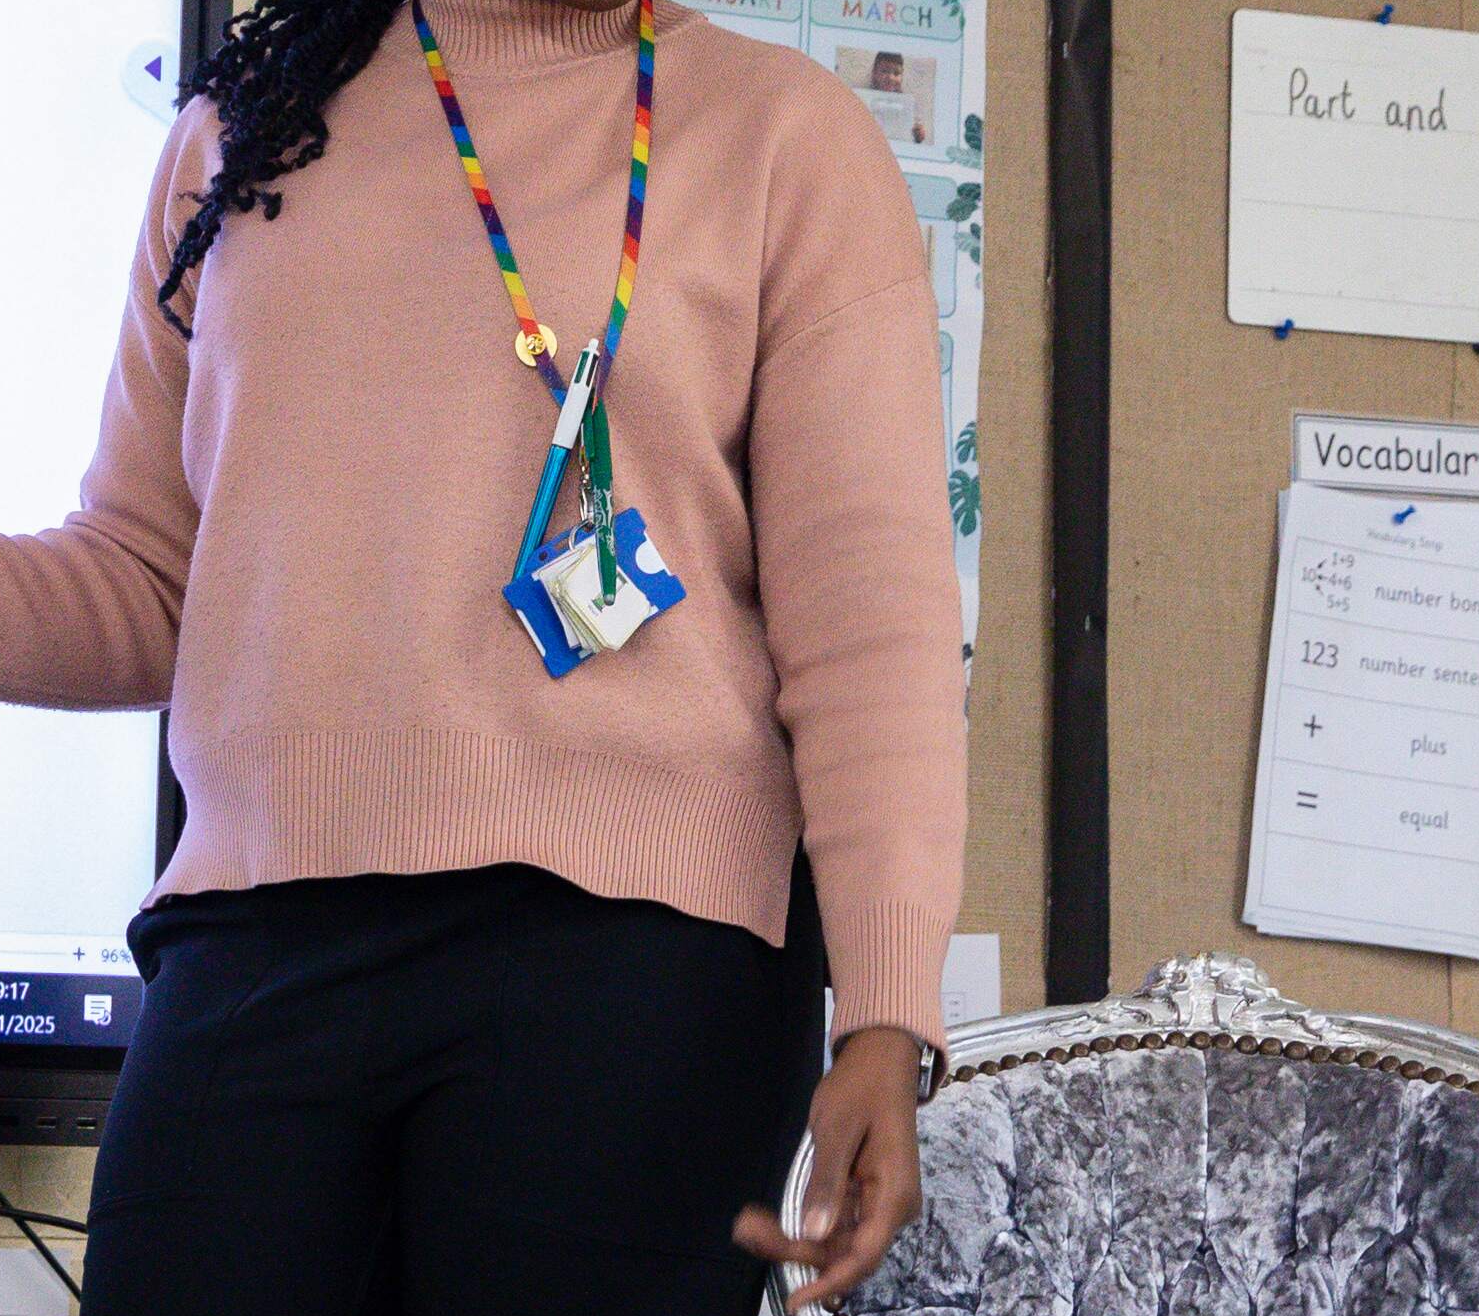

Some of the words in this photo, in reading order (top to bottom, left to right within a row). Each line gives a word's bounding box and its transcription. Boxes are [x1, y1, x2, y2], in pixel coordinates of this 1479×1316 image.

[842, 0, 933, 29] MARCH
[1289, 67, 1356, 120] Part
[1385, 88, 1448, 132] and
[1375, 586, 1443, 608] number
[1301, 639, 1339, 669] 123
[1359, 656, 1426, 678] number
[1410, 734, 1447, 758] plus
[1399, 810, 1449, 833] equal
